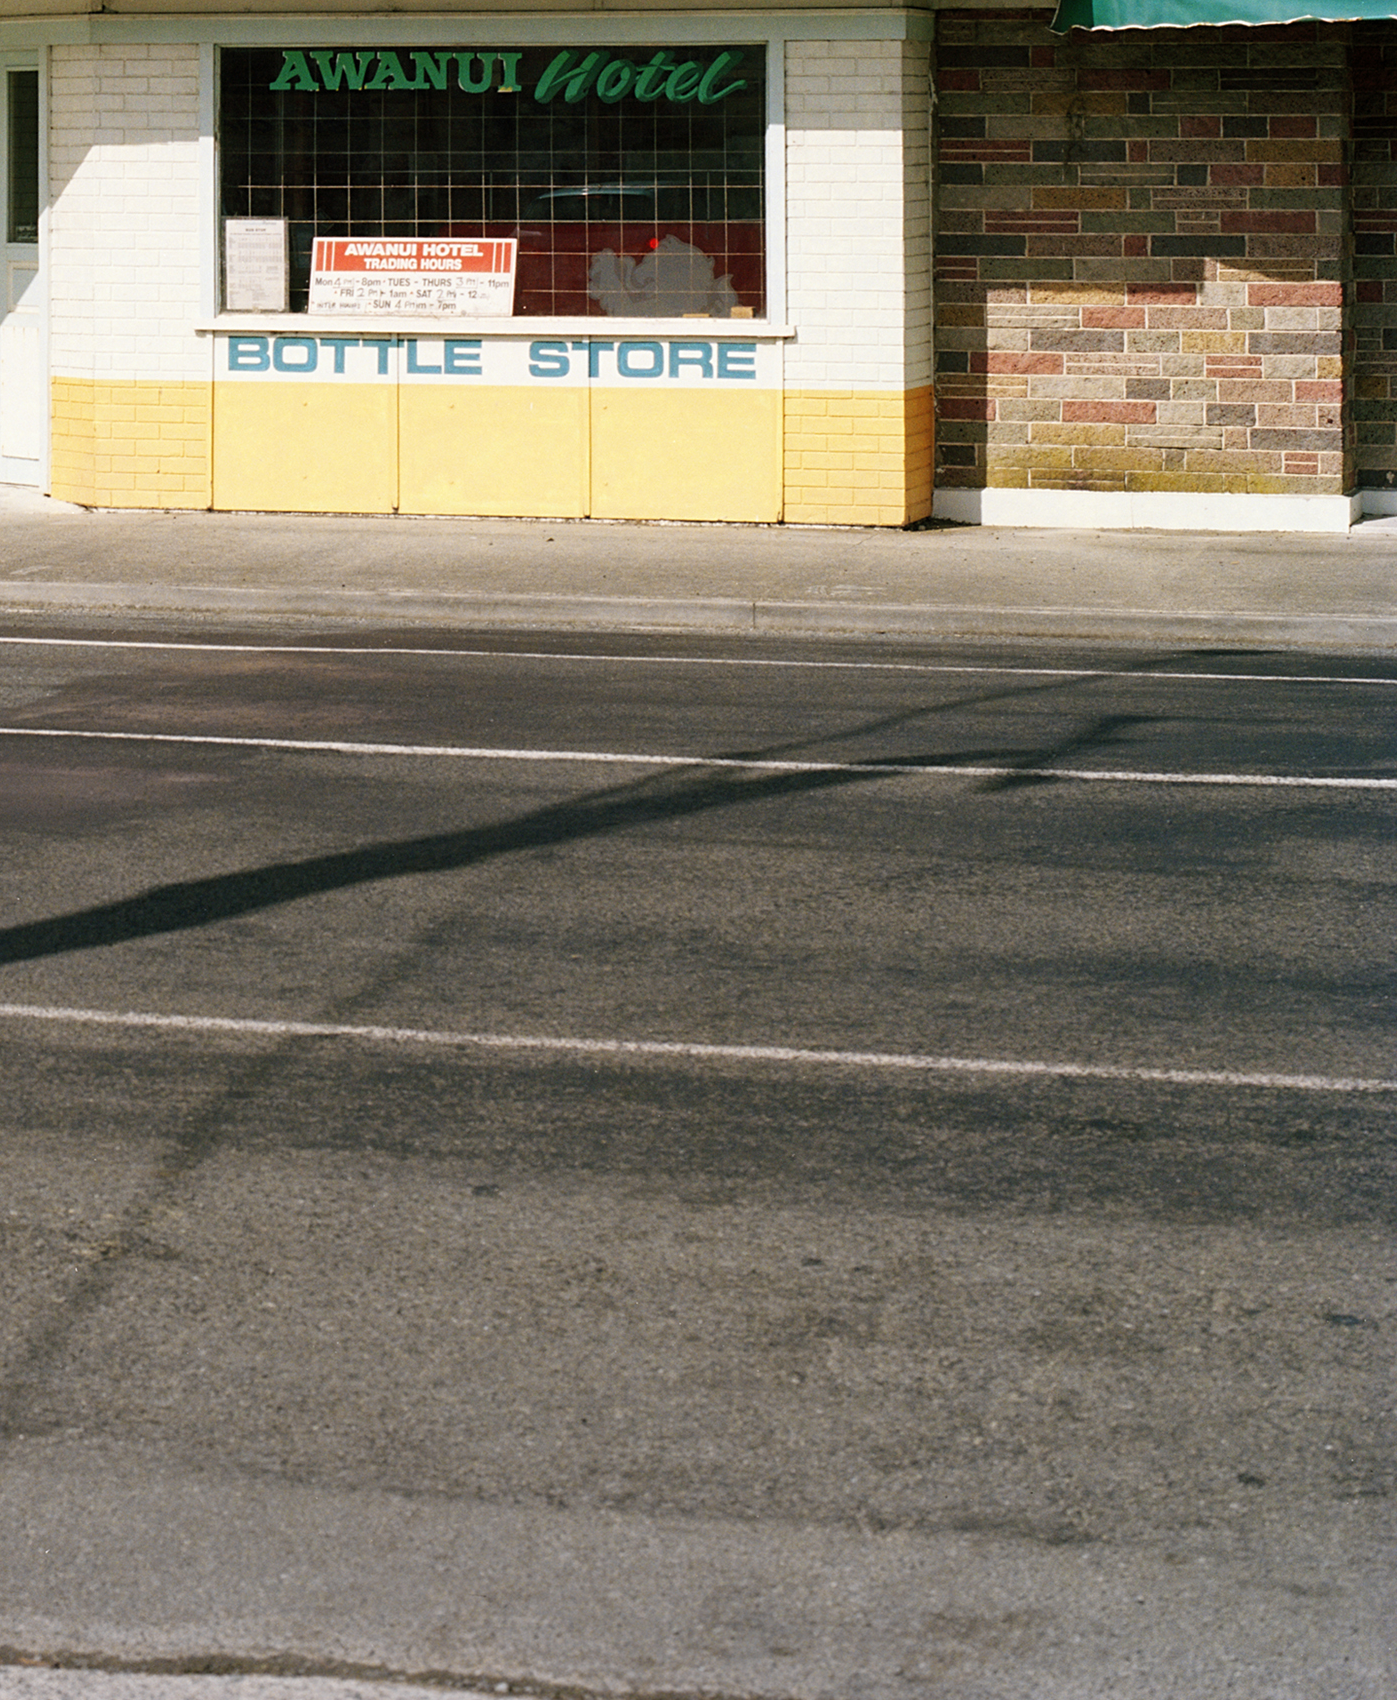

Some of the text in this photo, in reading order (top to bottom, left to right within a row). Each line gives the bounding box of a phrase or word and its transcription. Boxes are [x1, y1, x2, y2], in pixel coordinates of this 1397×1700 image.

[269, 50, 748, 104] AWANUI Hotel
[344, 243, 484, 257] AWANUI HOTEL
[364, 258, 462, 270] TRADING HOURS
[315, 277, 333, 286] Mon
[388, 278, 410, 287] TUES
[422, 278, 452, 287] THURS
[488, 279, 509, 289] 11pm
[340, 289, 354, 297] FRI
[390, 289, 407, 298] 1am
[416, 289, 432, 298] SAT
[373, 300, 391, 309] SUN
[438, 301, 456, 311] 7pm
[228, 335, 757, 380] BOTTLE STORE
